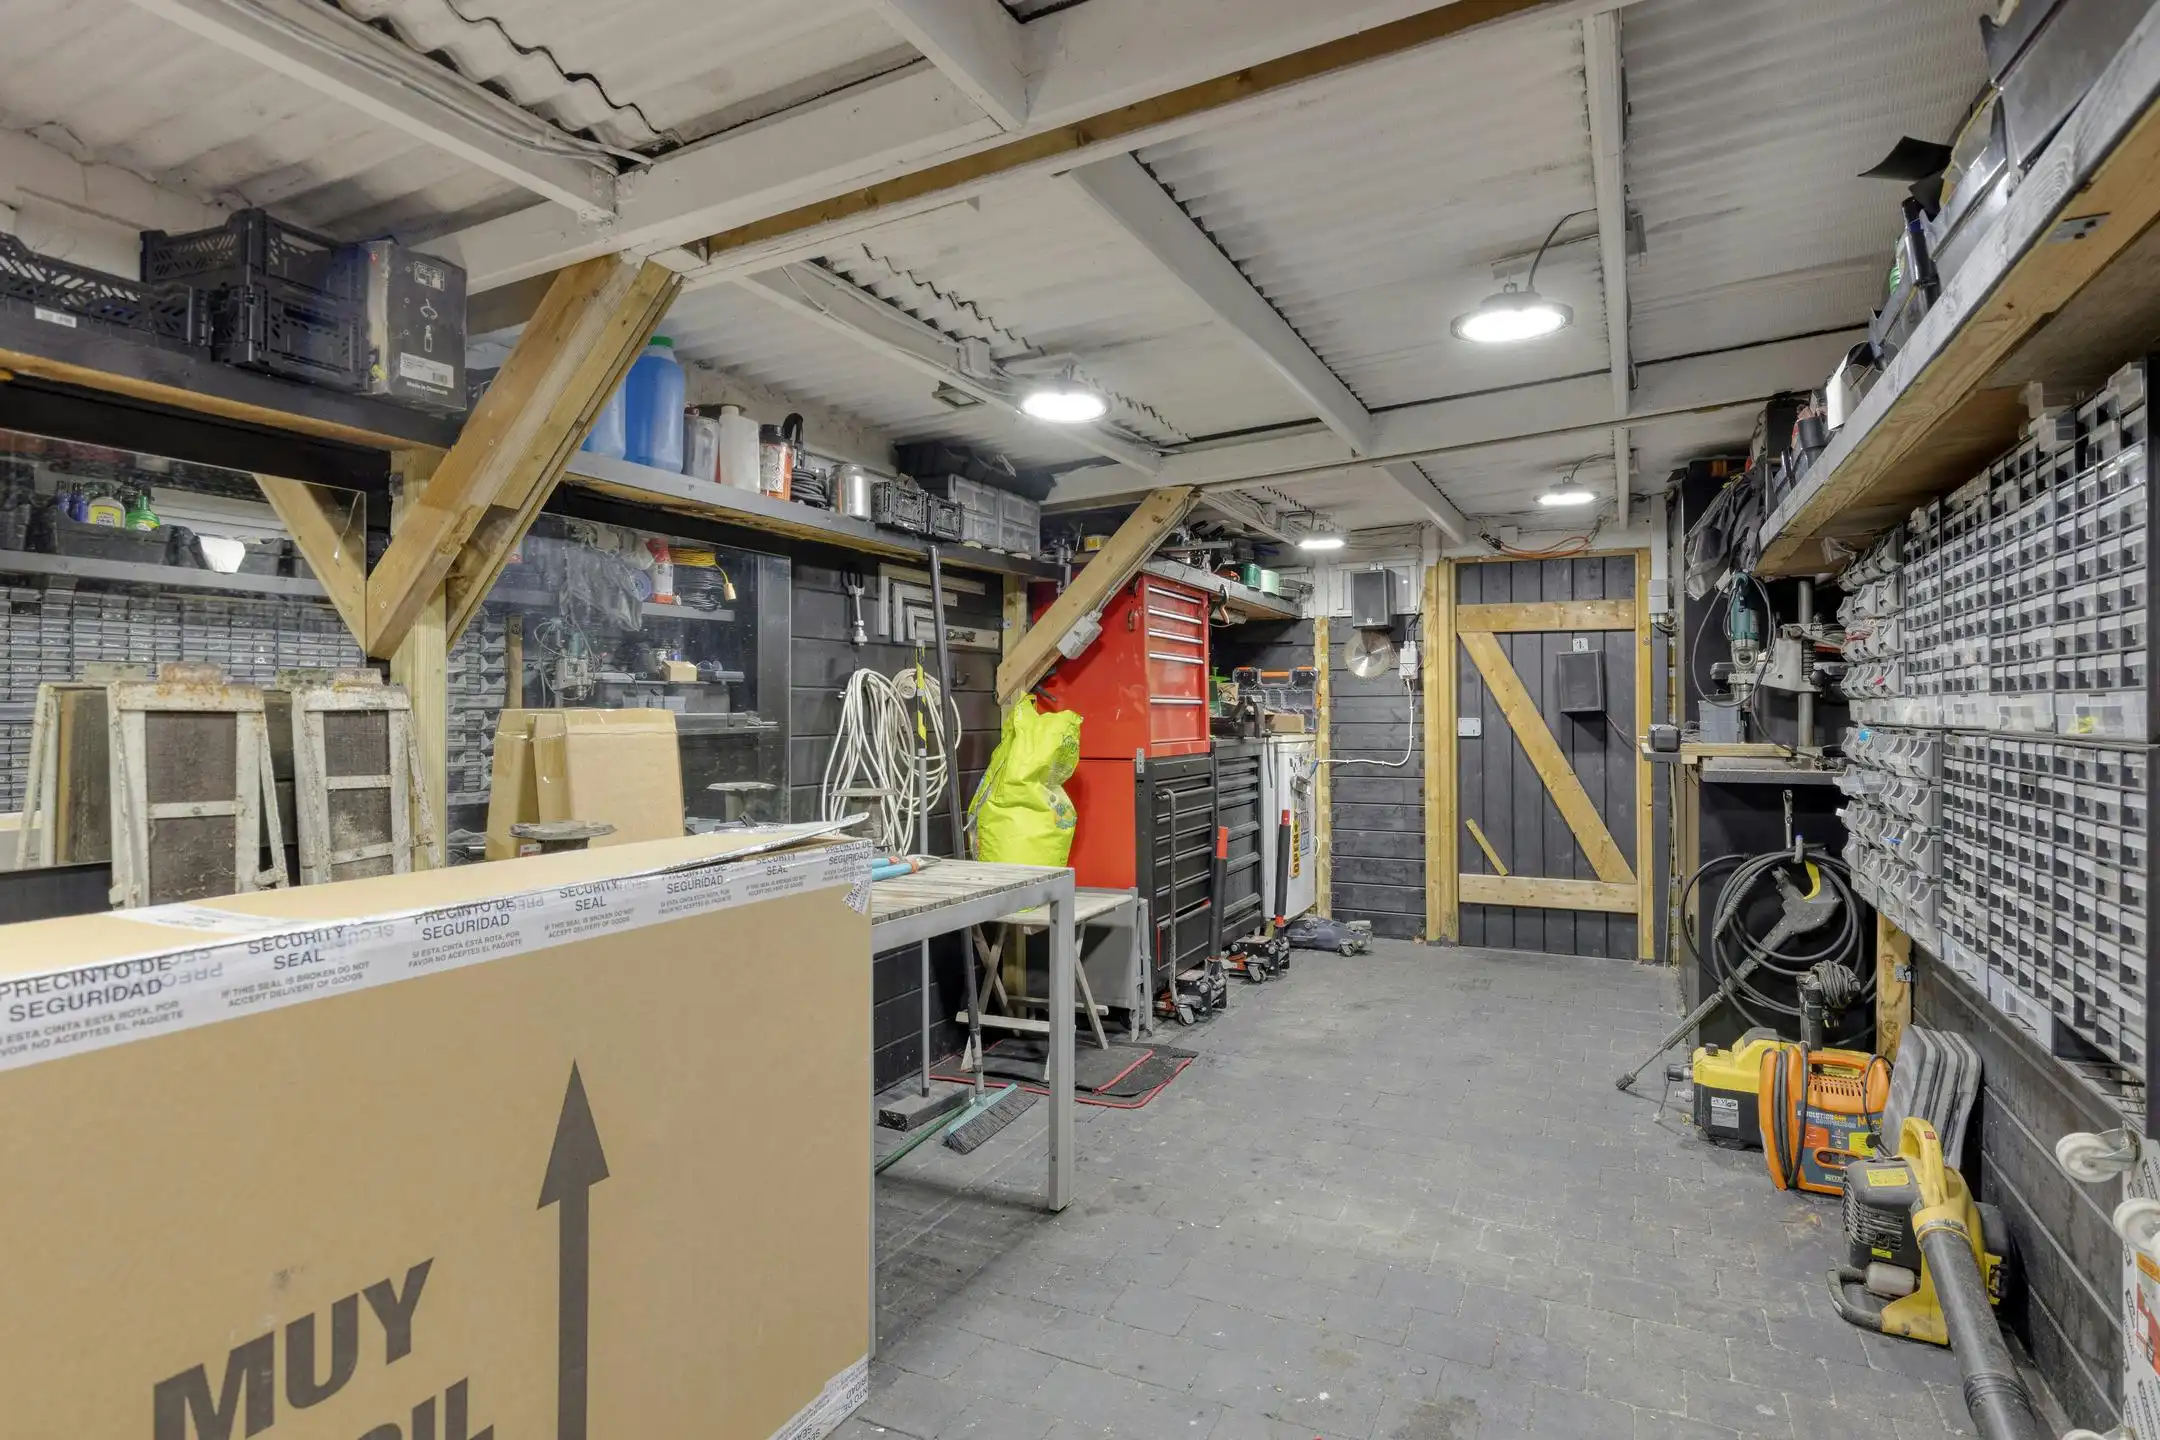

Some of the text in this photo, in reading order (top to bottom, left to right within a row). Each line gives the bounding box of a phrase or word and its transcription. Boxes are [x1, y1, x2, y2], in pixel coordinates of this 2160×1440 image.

[766, 866, 788, 876] SEAL
[829, 851, 870, 865] SEGURIDAD
[559, 880, 618, 899] SECURITY
[667, 875, 724, 894] SEGURIDAD
[415, 901, 491, 925] PRECINTO
[575, 896, 607, 912] SEAL
[249, 925, 344, 955] SECURITY
[422, 913, 510, 941] SEGURIDAD
[442, 941, 463, 953] CINTA
[505, 930, 520, 940] POR
[273, 949, 325, 970] SEAL
[408, 957, 434, 968] FAVOR
[435, 954, 446, 962] NO
[447, 947, 480, 961] ACEPTES
[492, 938, 523, 950] PAQUETE
[0, 961, 131, 999] PRECINTO
[140, 954, 174, 974] DE
[228, 972, 363, 1008] ACCEPT DELIVERY OF GOODS
[232, 985, 256, 997] THIS
[257, 980, 282, 991] SEAL
[285, 976, 294, 985] IS
[296, 969, 335, 983] BROKEN
[337, 965, 350, 974] DO
[352, 961, 371, 971] NOT
[9, 977, 163, 1023] SEGURIDAD
[0, 1009, 184, 1057] VOR NO ACEPTES EL PAQUETE
[7, 1028, 41, 1044] ESTA
[43, 1020, 81, 1037] CINTA
[155, 1000, 180, 1014] POR
[154, 1257, 434, 1440] MUY
